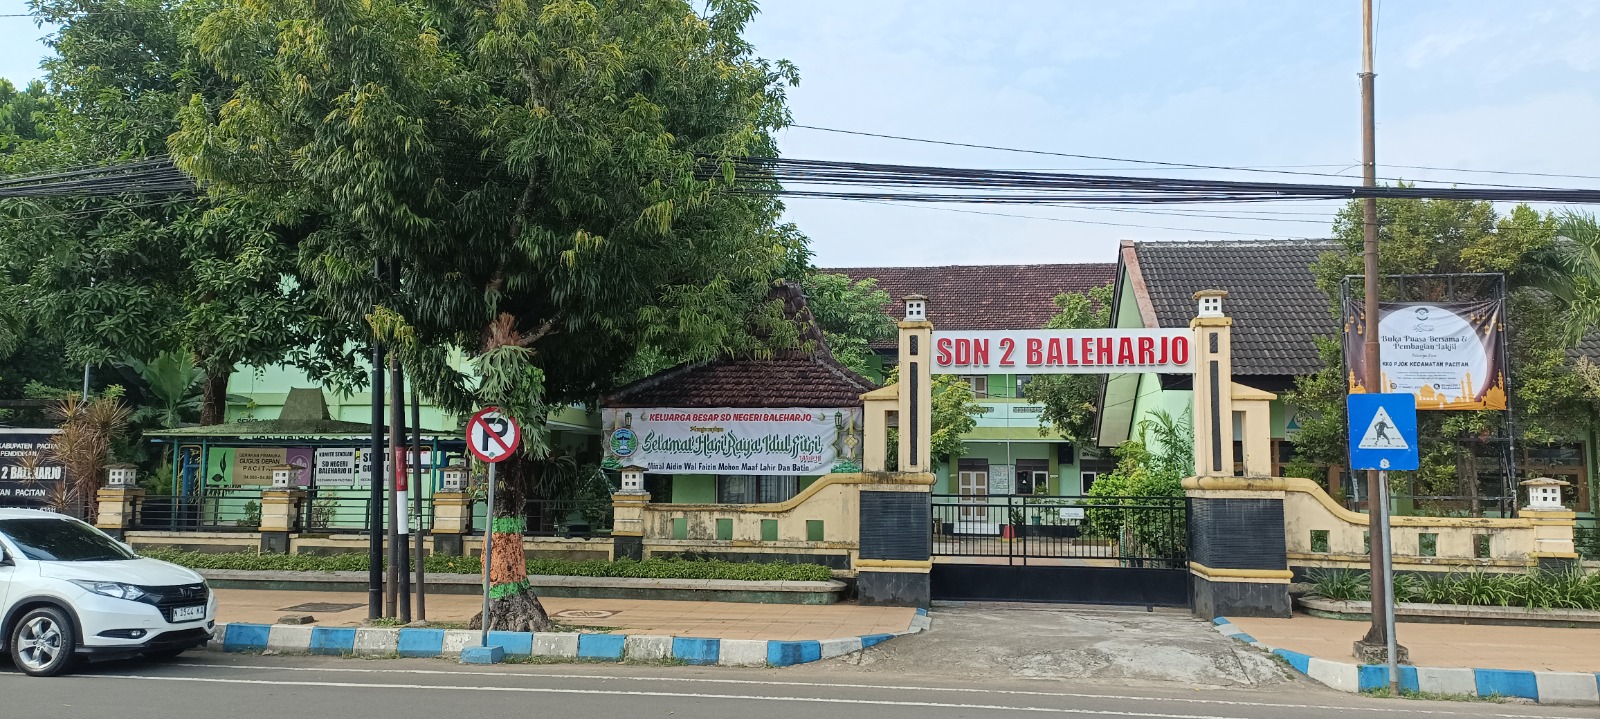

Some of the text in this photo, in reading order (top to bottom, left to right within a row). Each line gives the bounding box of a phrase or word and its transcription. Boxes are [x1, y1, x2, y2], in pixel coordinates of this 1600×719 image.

[1381, 335, 1402, 343] Buka
[1404, 335, 1427, 343] Puasa
[1428, 335, 1460, 343] Bersama
[936, 335, 1189, 366] SDN 2 BALEHARJO
[1393, 342, 1435, 351] Pembagian
[649, 413, 812, 422] KELUARGA BESAR SD NEGERI BALEHARJO
[642, 429, 823, 459] Selamat Hari Raya Idul Fitri
[666, 462, 682, 471] Aidin
[683, 462, 697, 471] Wal
[698, 462, 717, 471] Faizin
[718, 462, 740, 471] Mohon
[741, 462, 759, 471] Maaf
[760, 463, 776, 472] Lahir
[777, 463, 791, 472] Dan
[792, 463, 810, 472] Batin
[1, 466, 9, 480] 2
[15, 488, 46, 497] PACITAN
